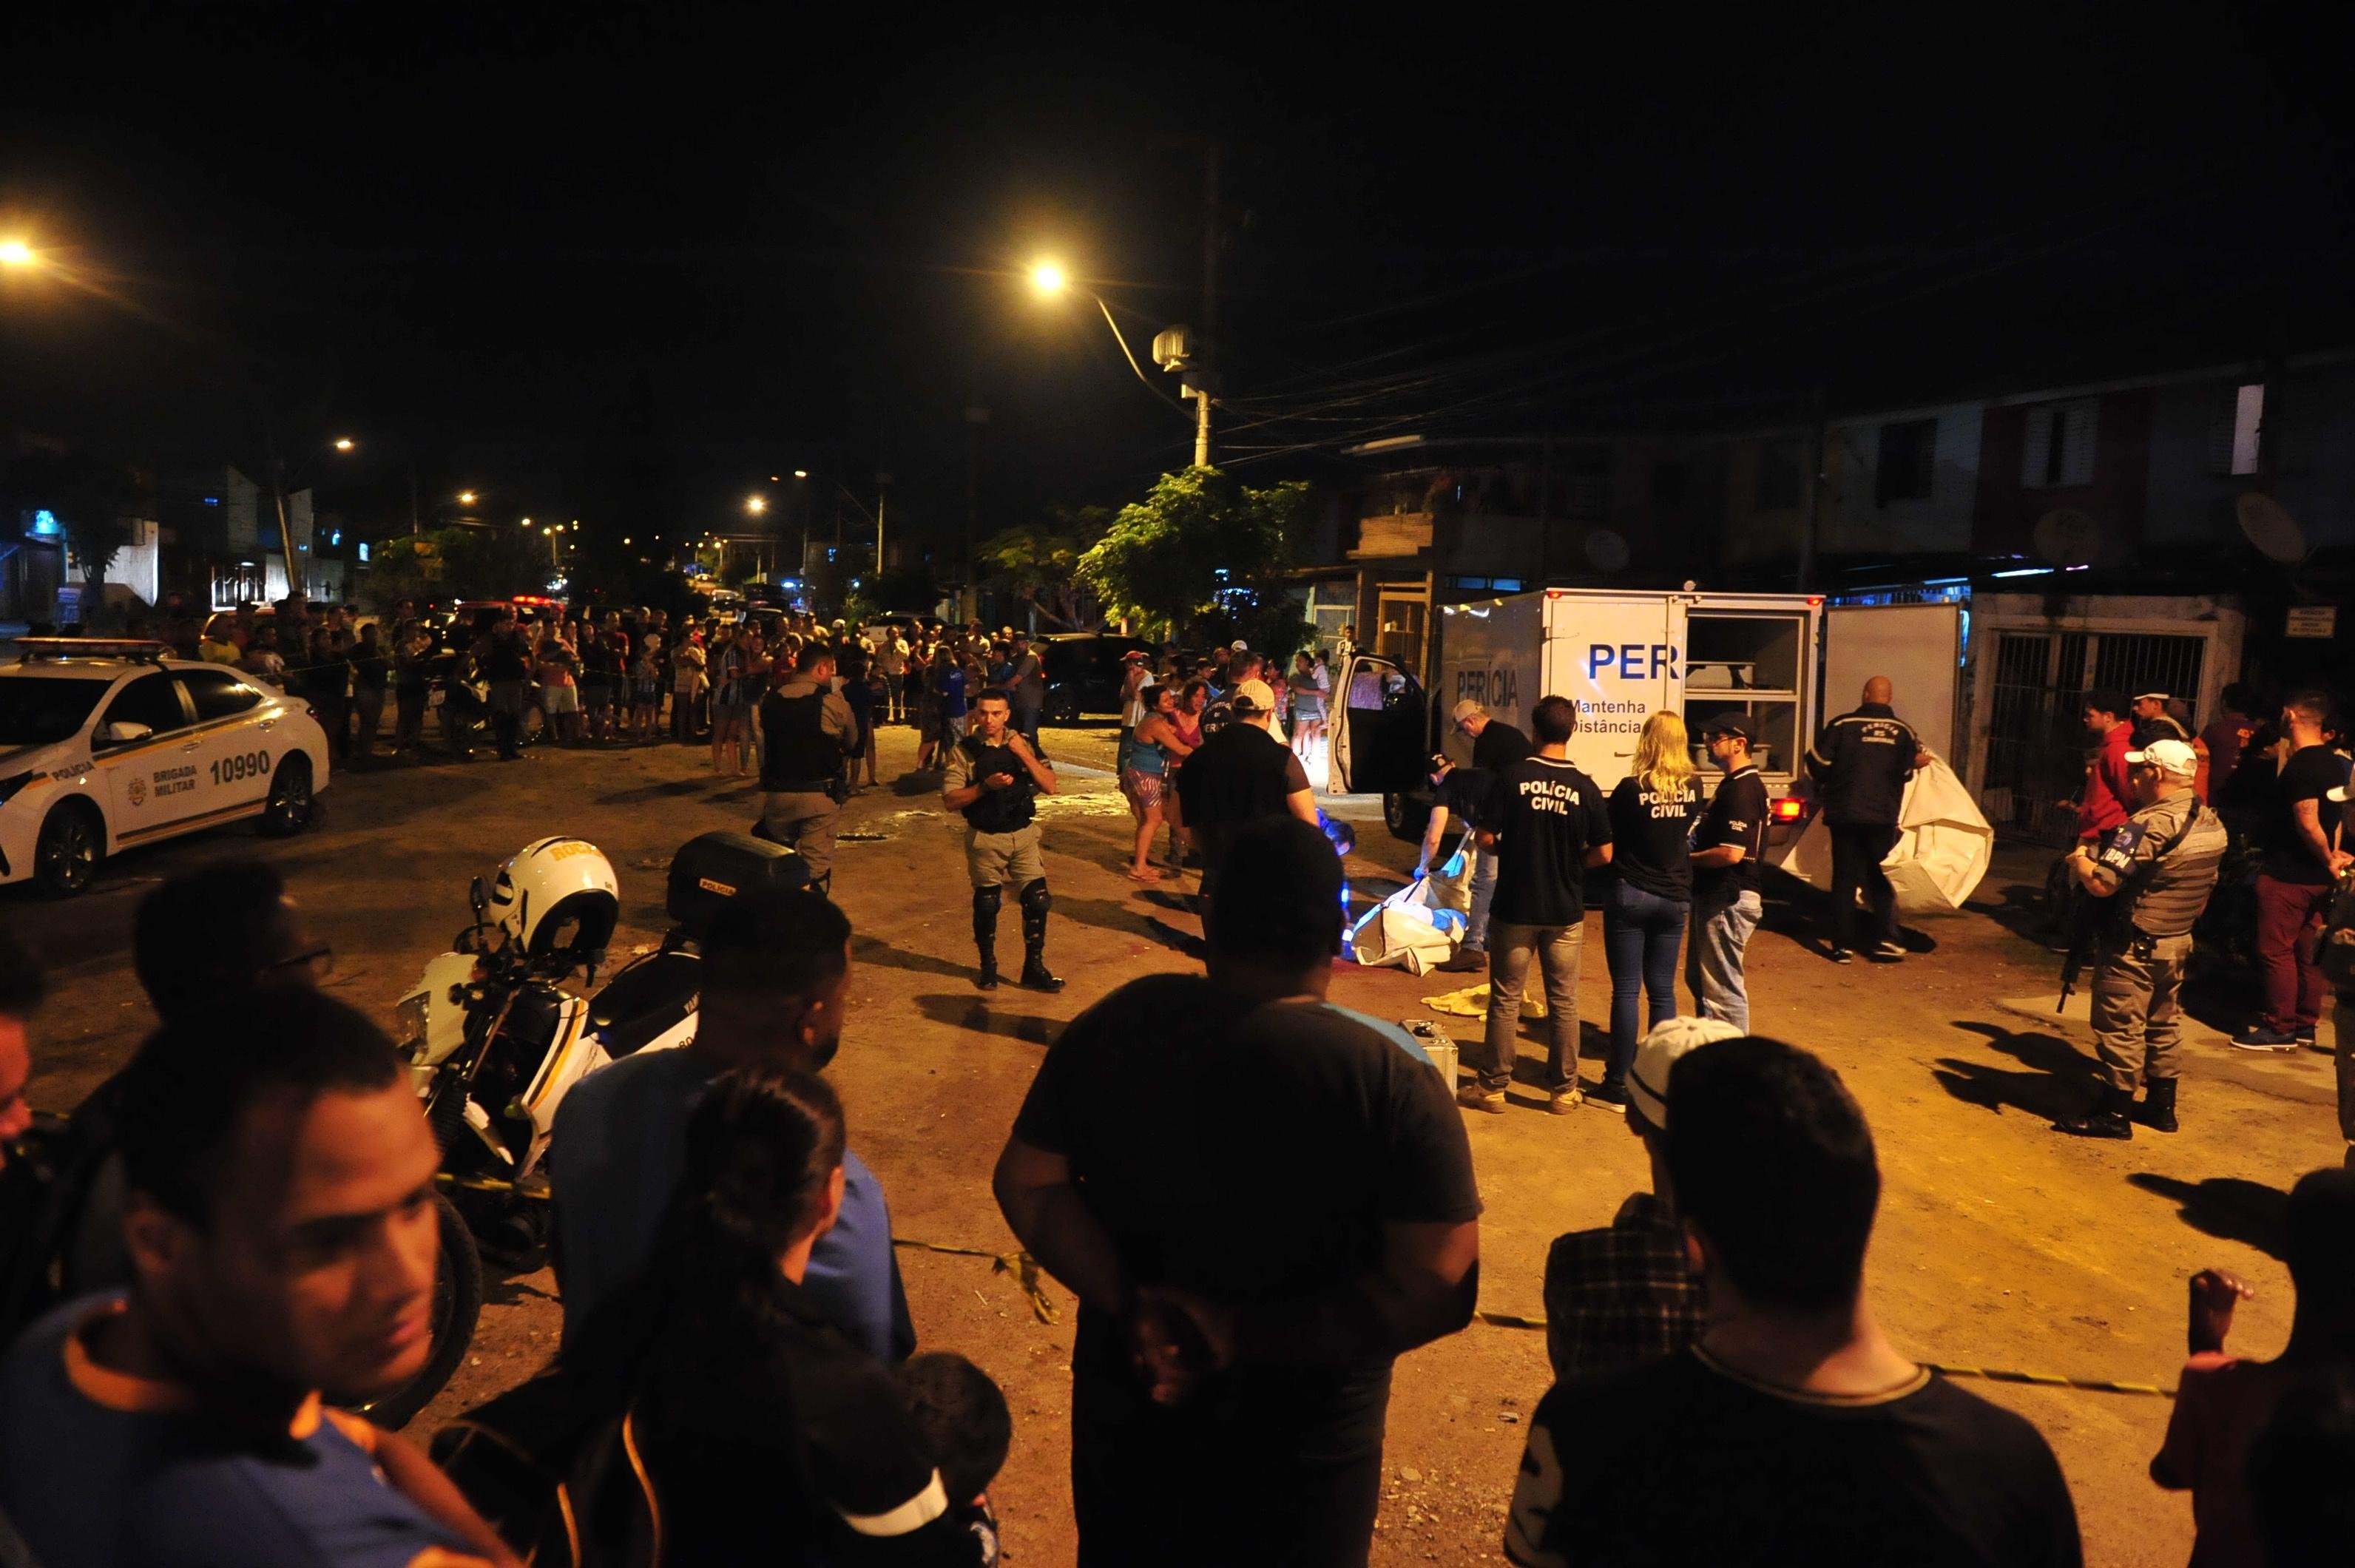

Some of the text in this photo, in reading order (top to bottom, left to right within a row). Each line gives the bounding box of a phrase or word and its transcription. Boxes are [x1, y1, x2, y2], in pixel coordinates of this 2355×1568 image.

[1589, 643, 1680, 680] PER
[1457, 661, 1518, 707] PERÍCIA
[1568, 699, 1646, 714] Mantenha
[153, 765, 197, 783] BRIGADA
[209, 750, 271, 785] 10990
[154, 779, 196, 797] MILITAR
[1519, 780, 1580, 805] POLÍCIA
[1639, 789, 1696, 805] POLCIA
[1531, 797, 1568, 815] CIVIL
[1651, 805, 1687, 819] CIVIL
